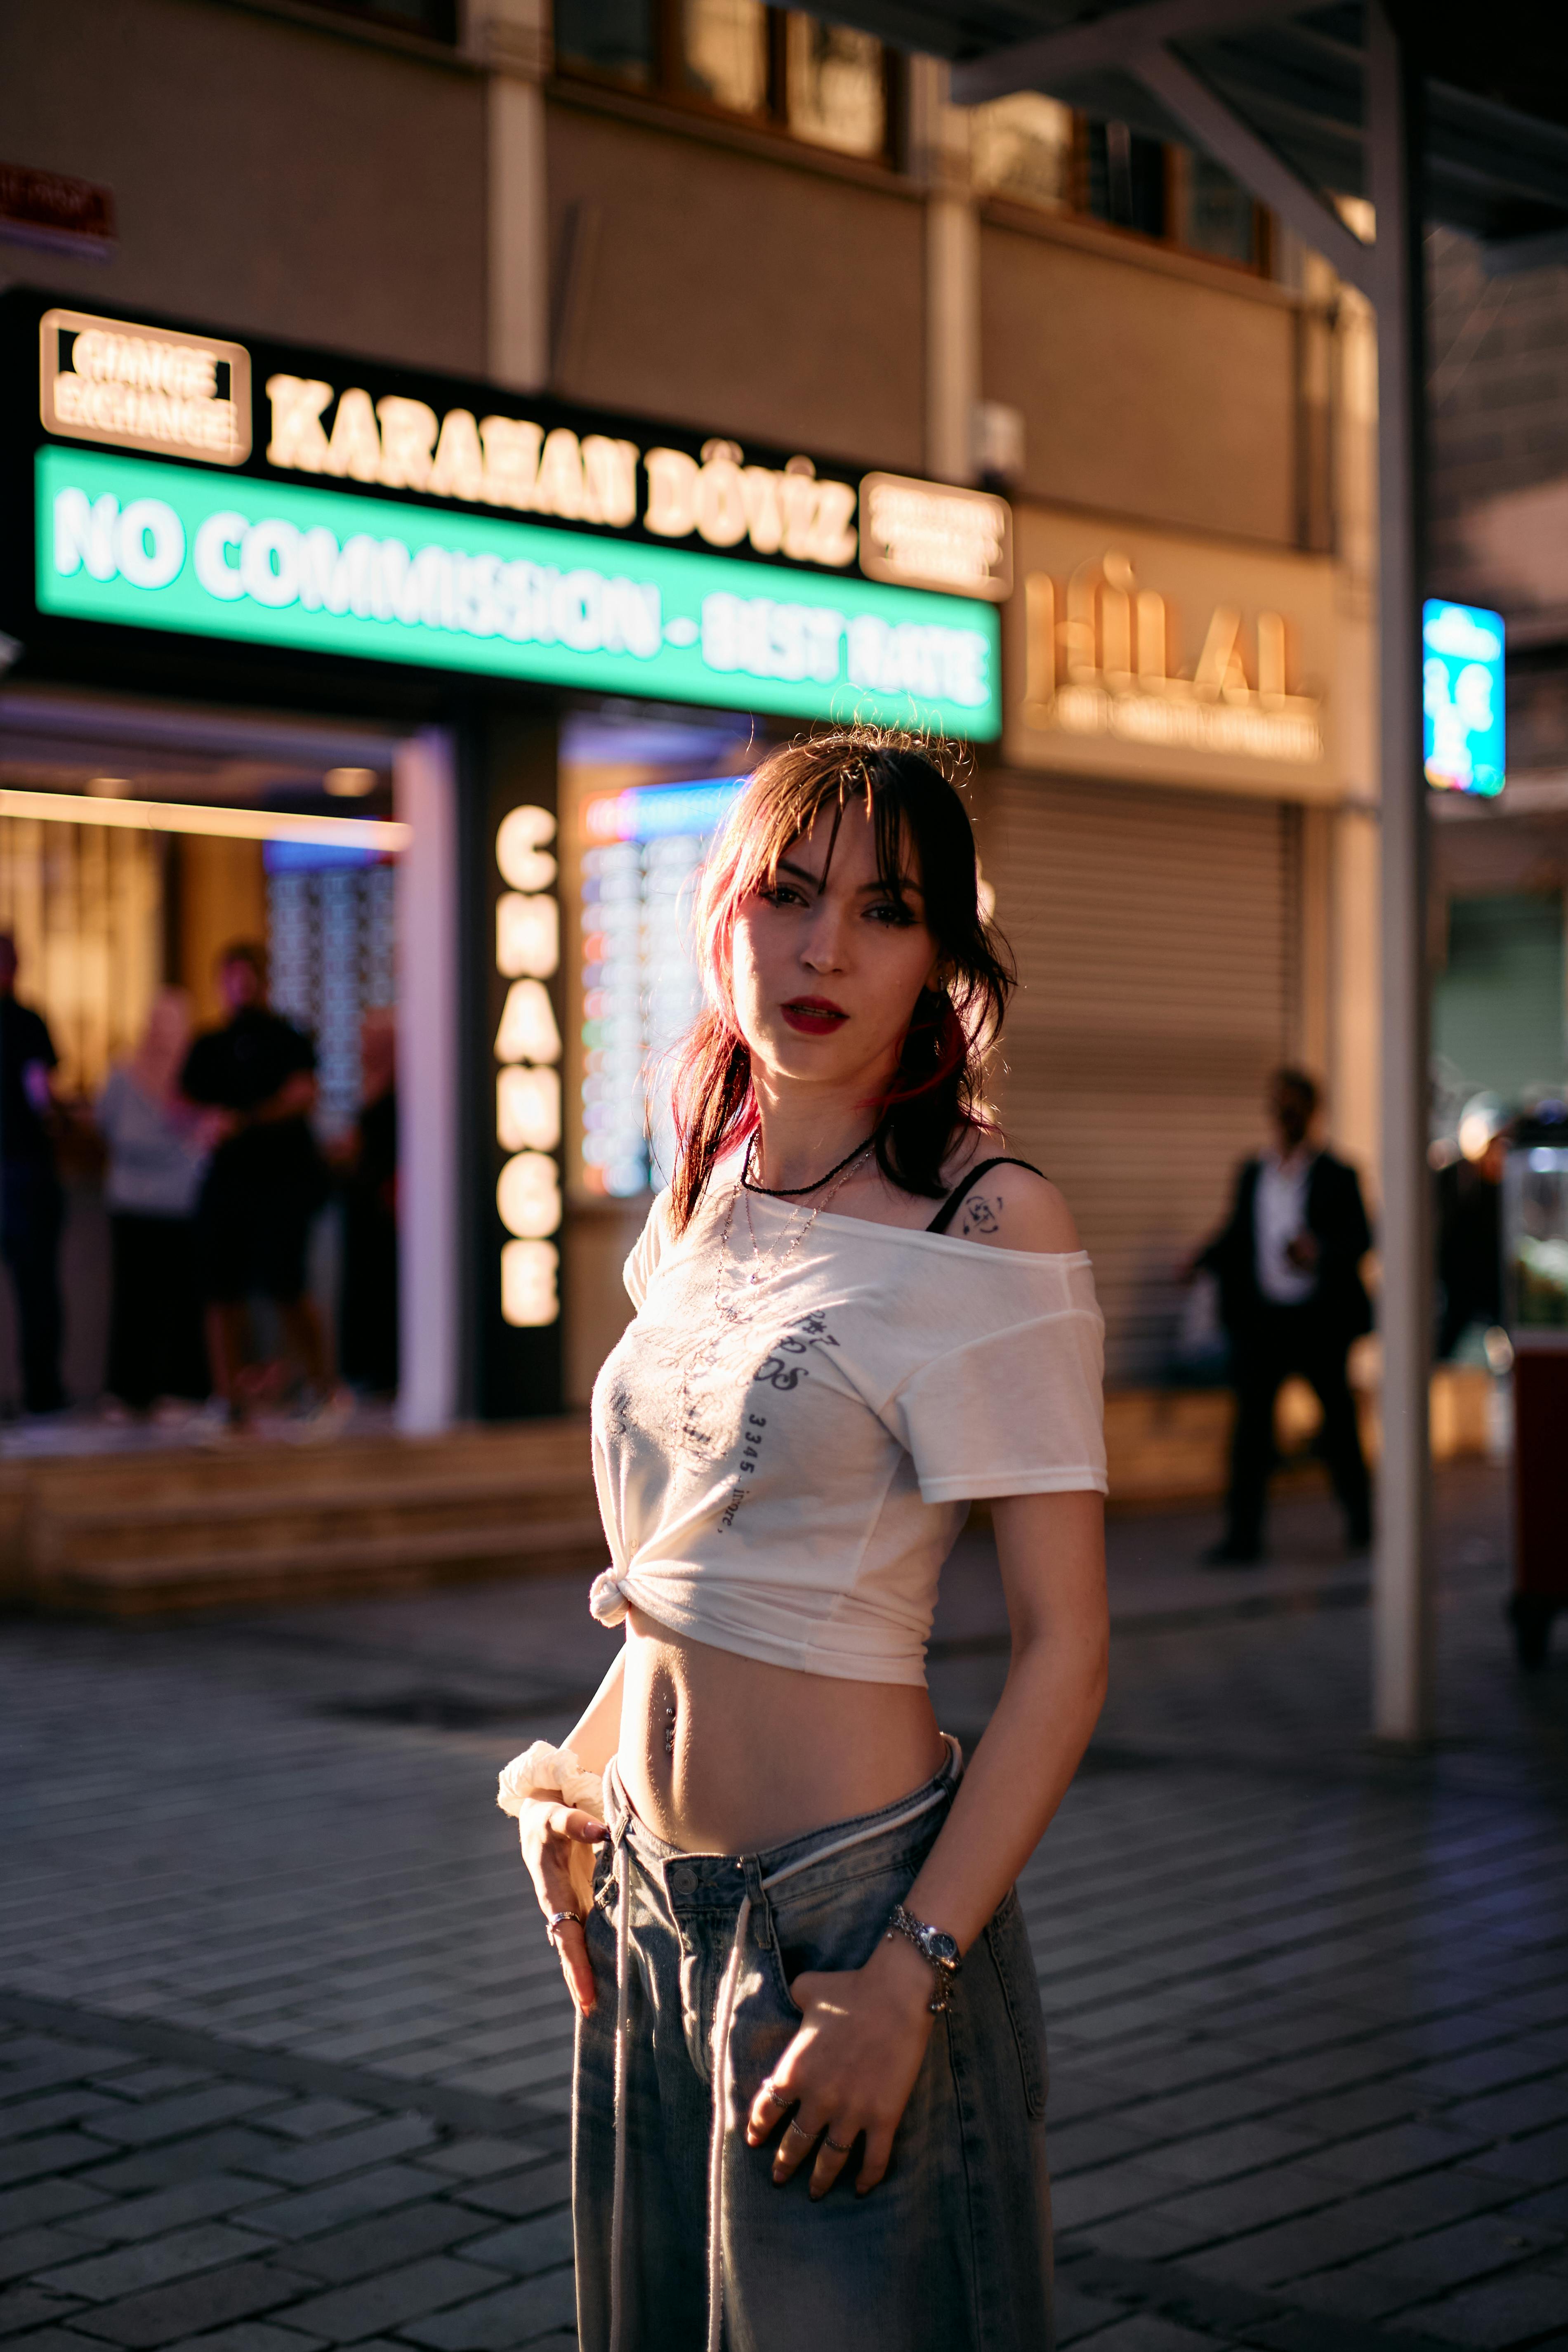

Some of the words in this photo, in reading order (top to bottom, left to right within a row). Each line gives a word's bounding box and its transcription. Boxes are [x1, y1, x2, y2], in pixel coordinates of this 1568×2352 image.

[72, 328, 218, 399] CHANGE
[53, 486, 187, 591] NO
[192, 510, 662, 659] COMMISSION
[700, 591, 842, 685] BEST
[844, 614, 990, 708] RATE
[494, 804, 562, 1328] CHANGE
